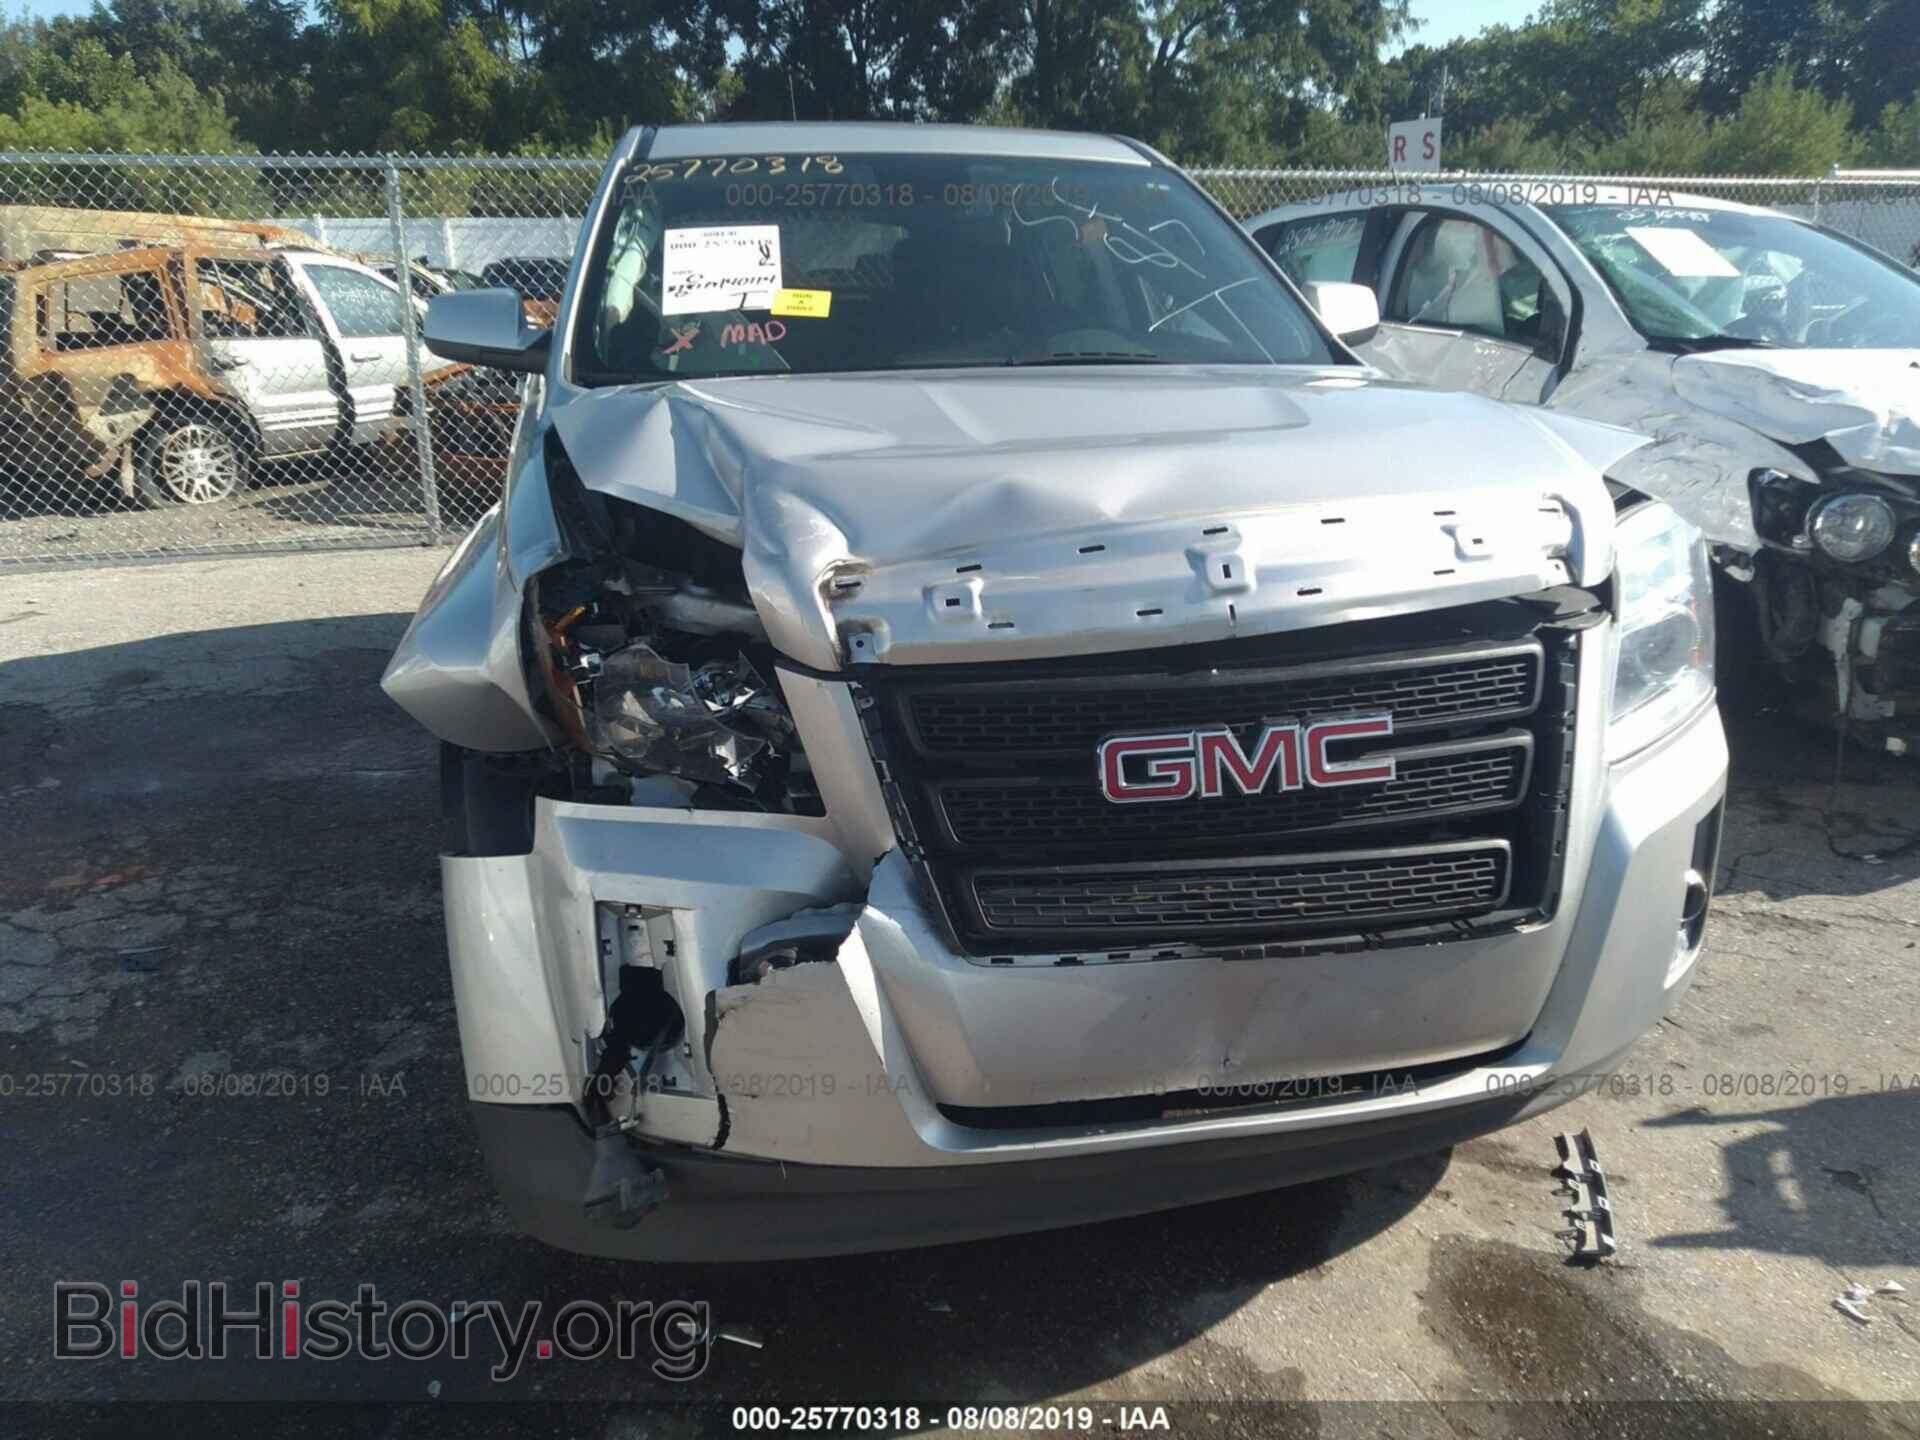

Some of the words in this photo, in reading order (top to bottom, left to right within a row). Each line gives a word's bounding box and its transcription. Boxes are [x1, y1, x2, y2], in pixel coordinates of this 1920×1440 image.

[1394, 134, 1407, 162] R
[1422, 130, 1435, 160] S
[720, 320, 786, 348] MAD
[1097, 711, 1397, 804] GMC
